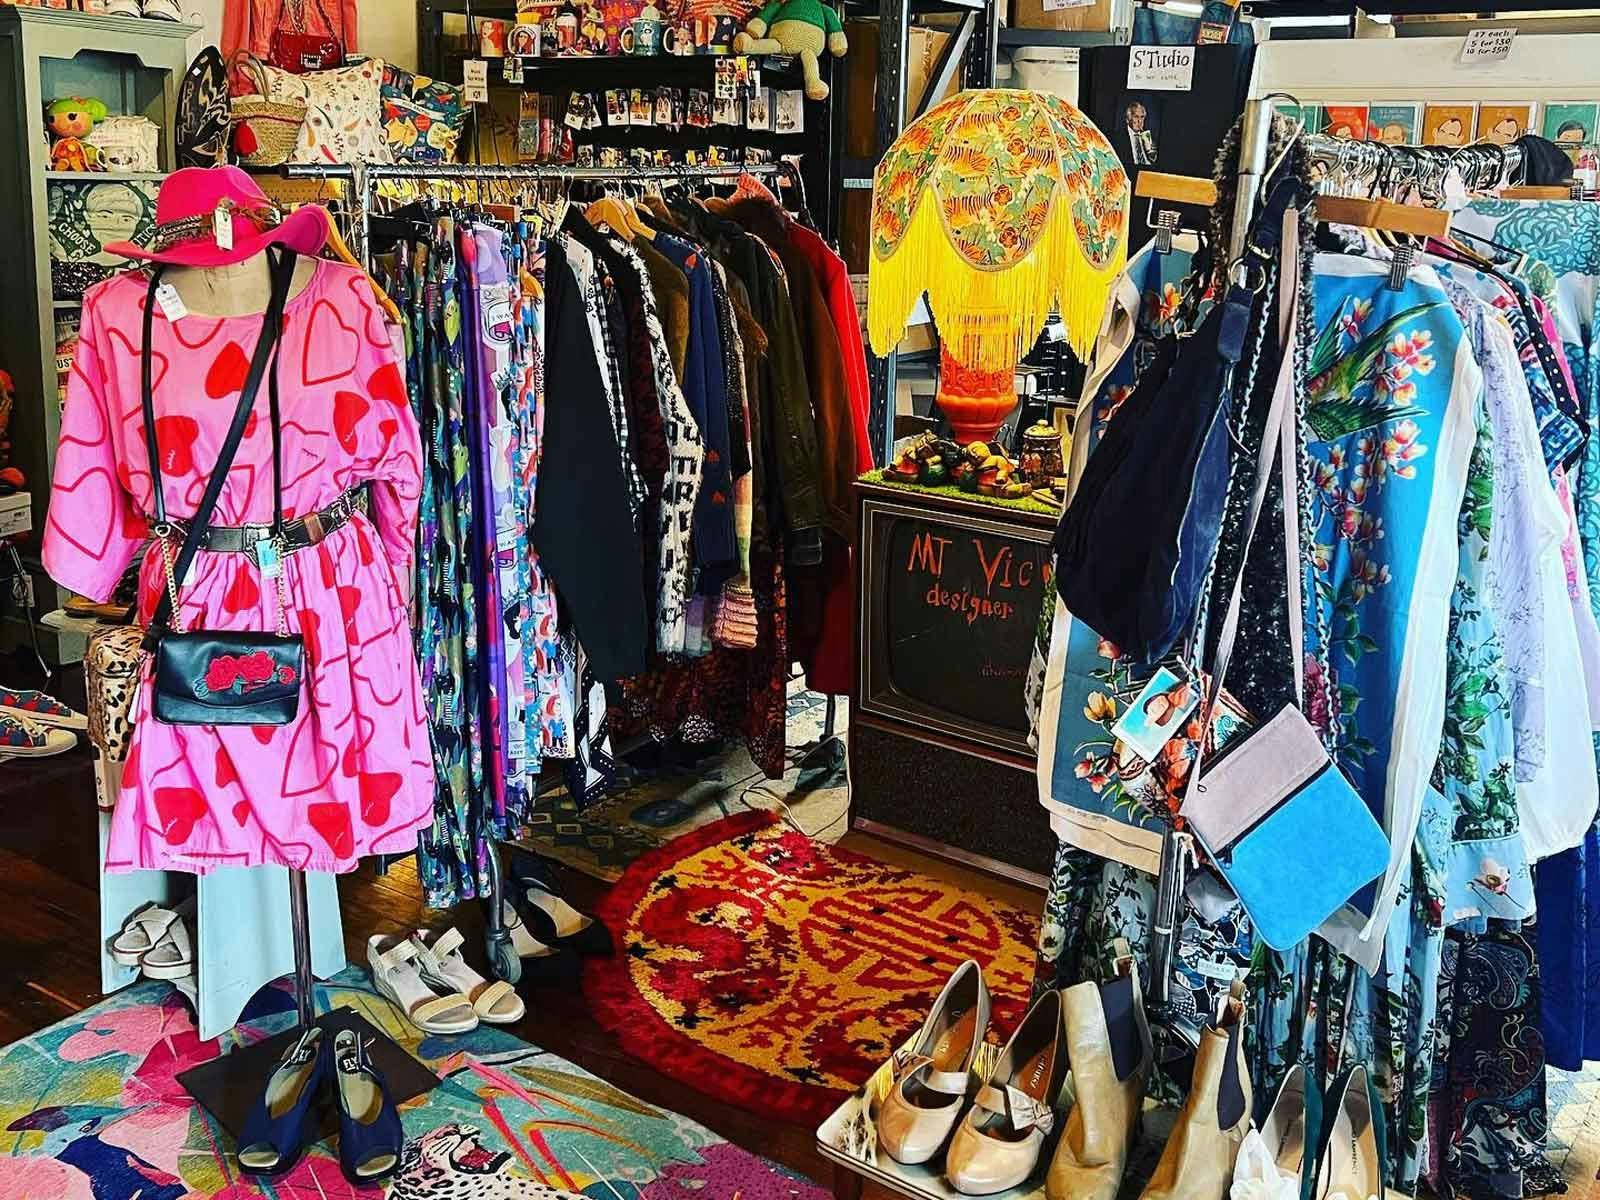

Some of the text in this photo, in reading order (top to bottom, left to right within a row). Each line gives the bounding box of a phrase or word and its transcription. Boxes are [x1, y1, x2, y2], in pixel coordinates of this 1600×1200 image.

[1488, 30, 1510, 38] each
[1491, 46, 1509, 54] $50
[58, 222, 97, 255] CHOOSE
[926, 581, 1013, 626] designer
[342, 1056, 360, 1072] FLY
